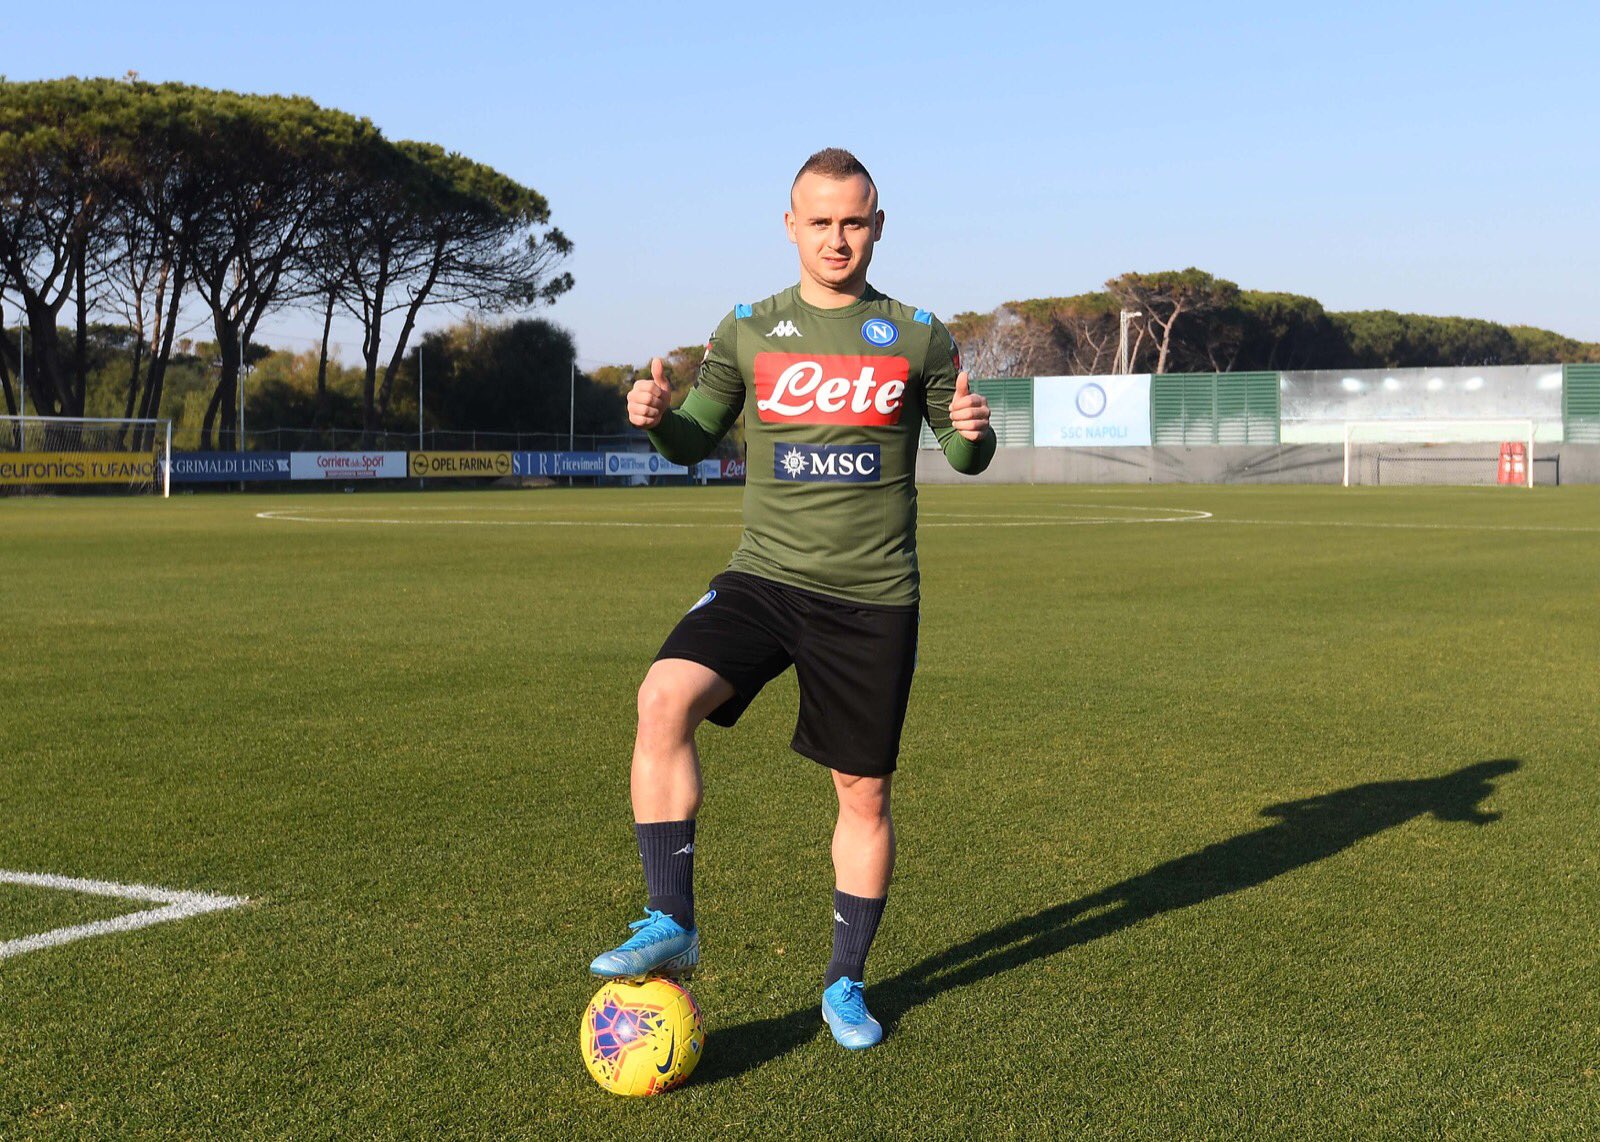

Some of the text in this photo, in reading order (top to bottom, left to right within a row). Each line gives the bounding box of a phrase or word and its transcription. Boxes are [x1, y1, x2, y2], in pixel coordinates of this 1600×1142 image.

[871, 325, 888, 339] N
[757, 361, 905, 417] Lete
[1060, 425, 1128, 439] SSC NAPOLI
[0, 458, 85, 478] euronics
[176, 459, 275, 473] GRIMALDI LINES
[317, 456, 350, 468] Corriere
[362, 455, 384, 471] Sport
[431, 458, 493, 471] OPEL FARINA
[562, 457, 604, 471] ricevimenti
[810, 452, 875, 475] MSC
